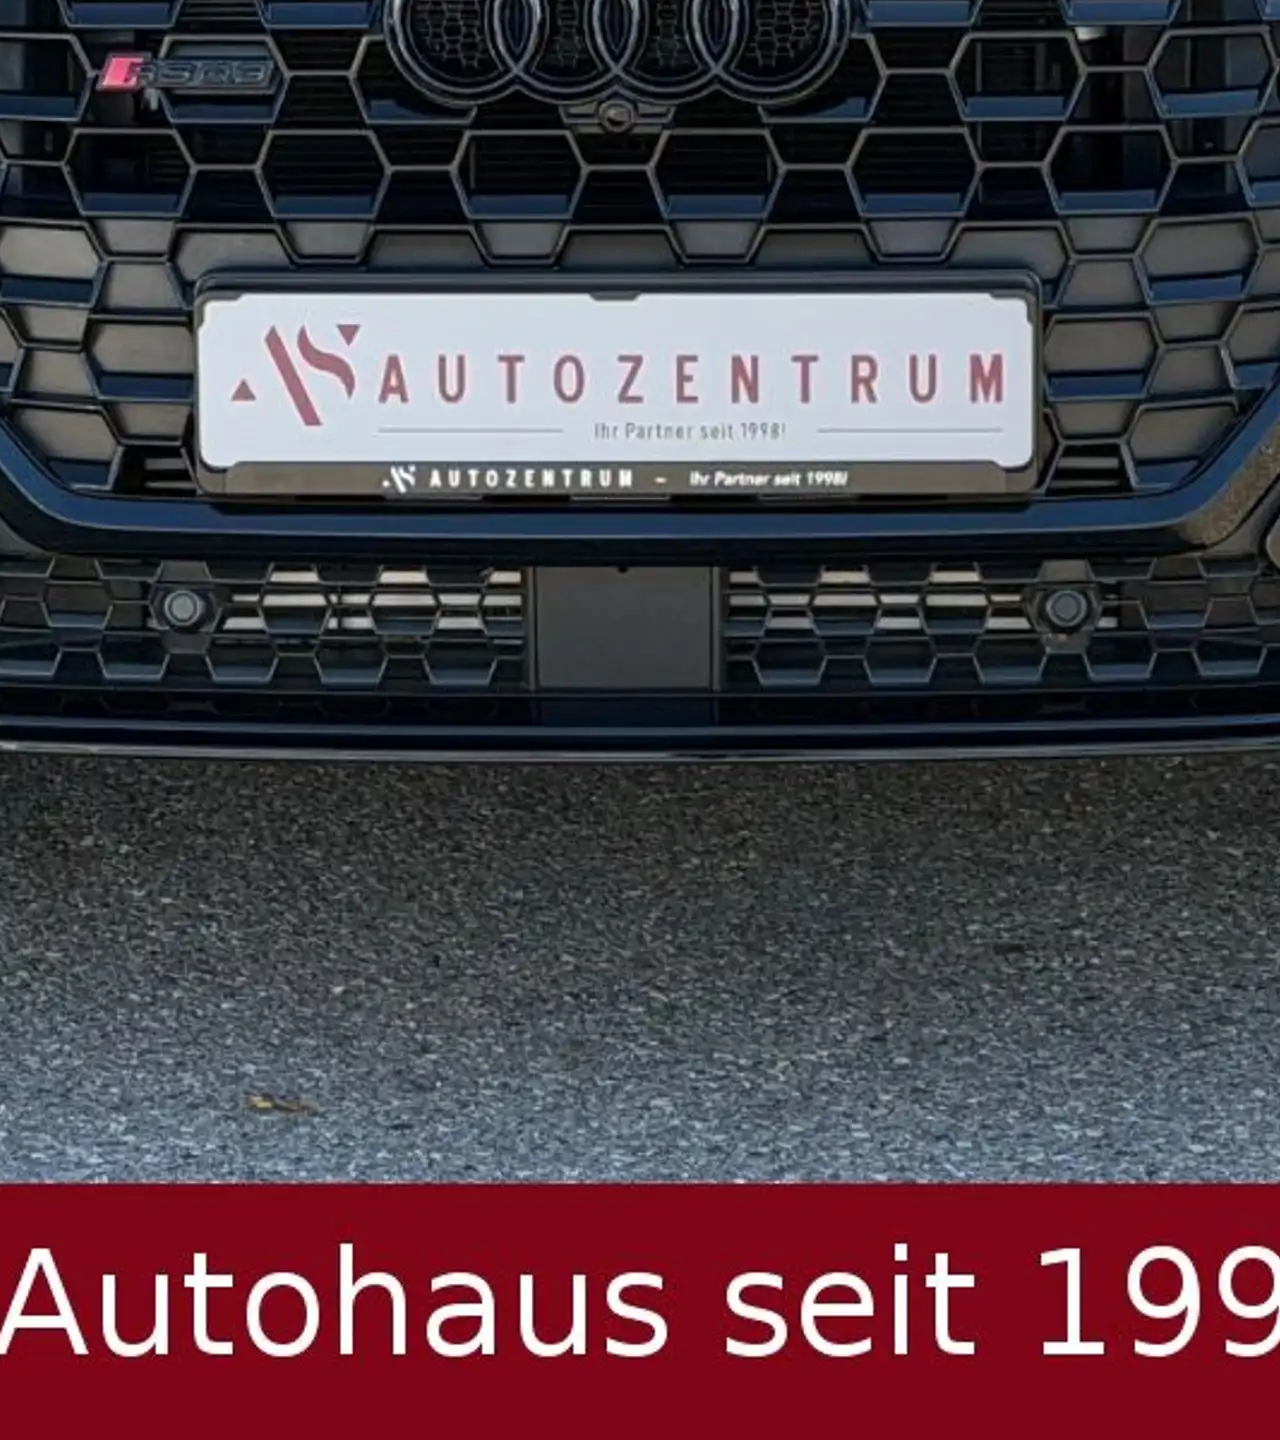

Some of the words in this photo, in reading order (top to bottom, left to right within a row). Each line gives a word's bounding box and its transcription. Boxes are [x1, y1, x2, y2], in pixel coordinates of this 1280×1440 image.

[377, 353, 1006, 405] AUTOZENTRUM
[593, 422, 618, 440] Ihr
[624, 422, 694, 440] Partner
[700, 422, 734, 440] seit
[428, 468, 633, 488] AUTOZENTRUM
[689, 470, 712, 487] Ihr
[714, 470, 771, 487] Partner
[774, 470, 801, 487] seit
